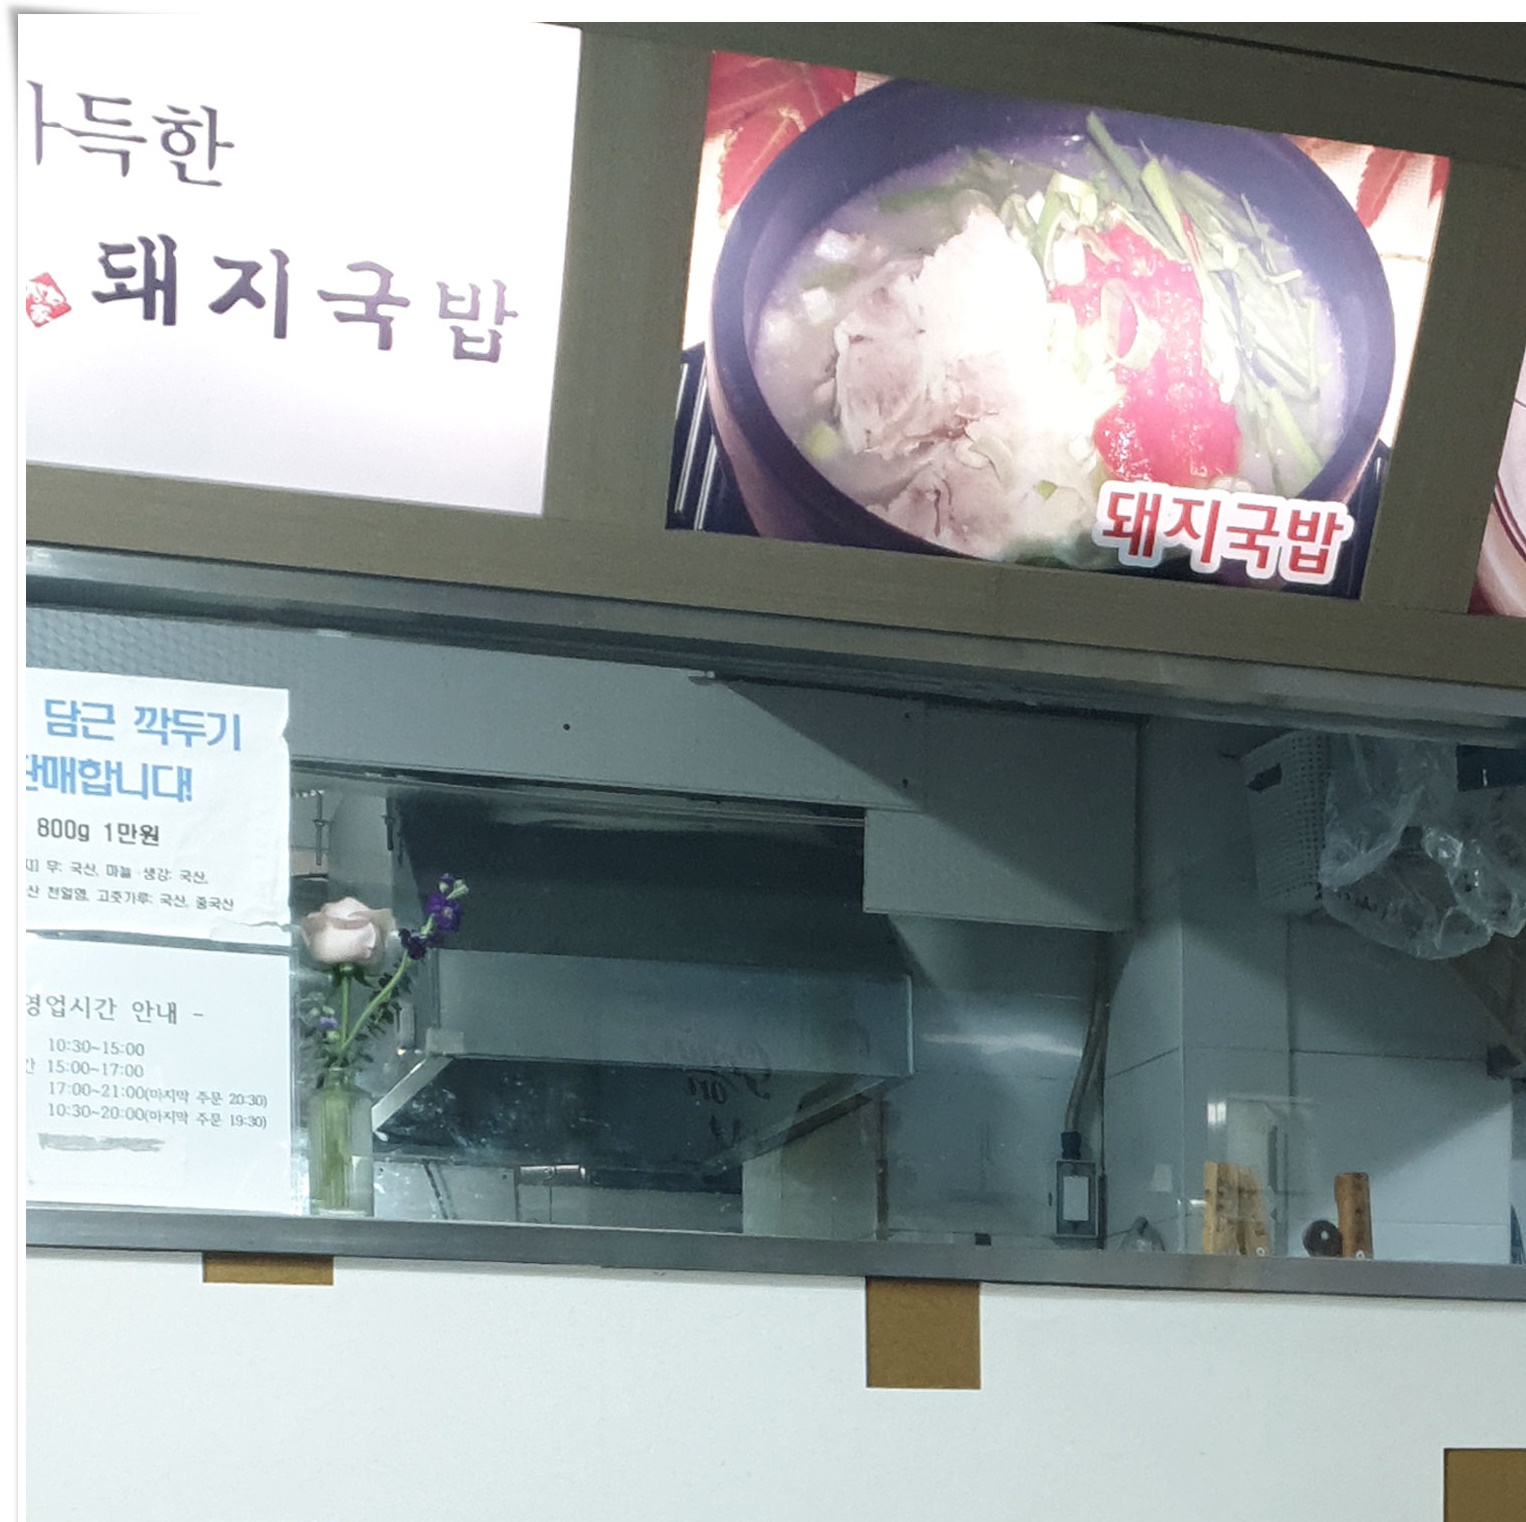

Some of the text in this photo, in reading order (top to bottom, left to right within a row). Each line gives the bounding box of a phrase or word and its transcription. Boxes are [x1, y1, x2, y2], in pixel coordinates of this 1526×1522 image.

[91, 234, 518, 363] 돼지국밥
[1102, 490, 1346, 580] 돼지국밥
[44, 699, 241, 751] 담근 깍두기
[37, 817, 160, 847] 800g 1만원
[196, 896, 235, 911] 중국산
[131, 1000, 178, 1025] 안내
[48, 1037, 145, 1057] 10:30~15:00
[47, 1059, 144, 1078] 15:00~17:00
[196, 1091, 223, 1106] 주문
[229, 1093, 268, 1108] 20:30)
[196, 1112, 222, 1127] 주문
[229, 1114, 268, 1130] 19:30)
